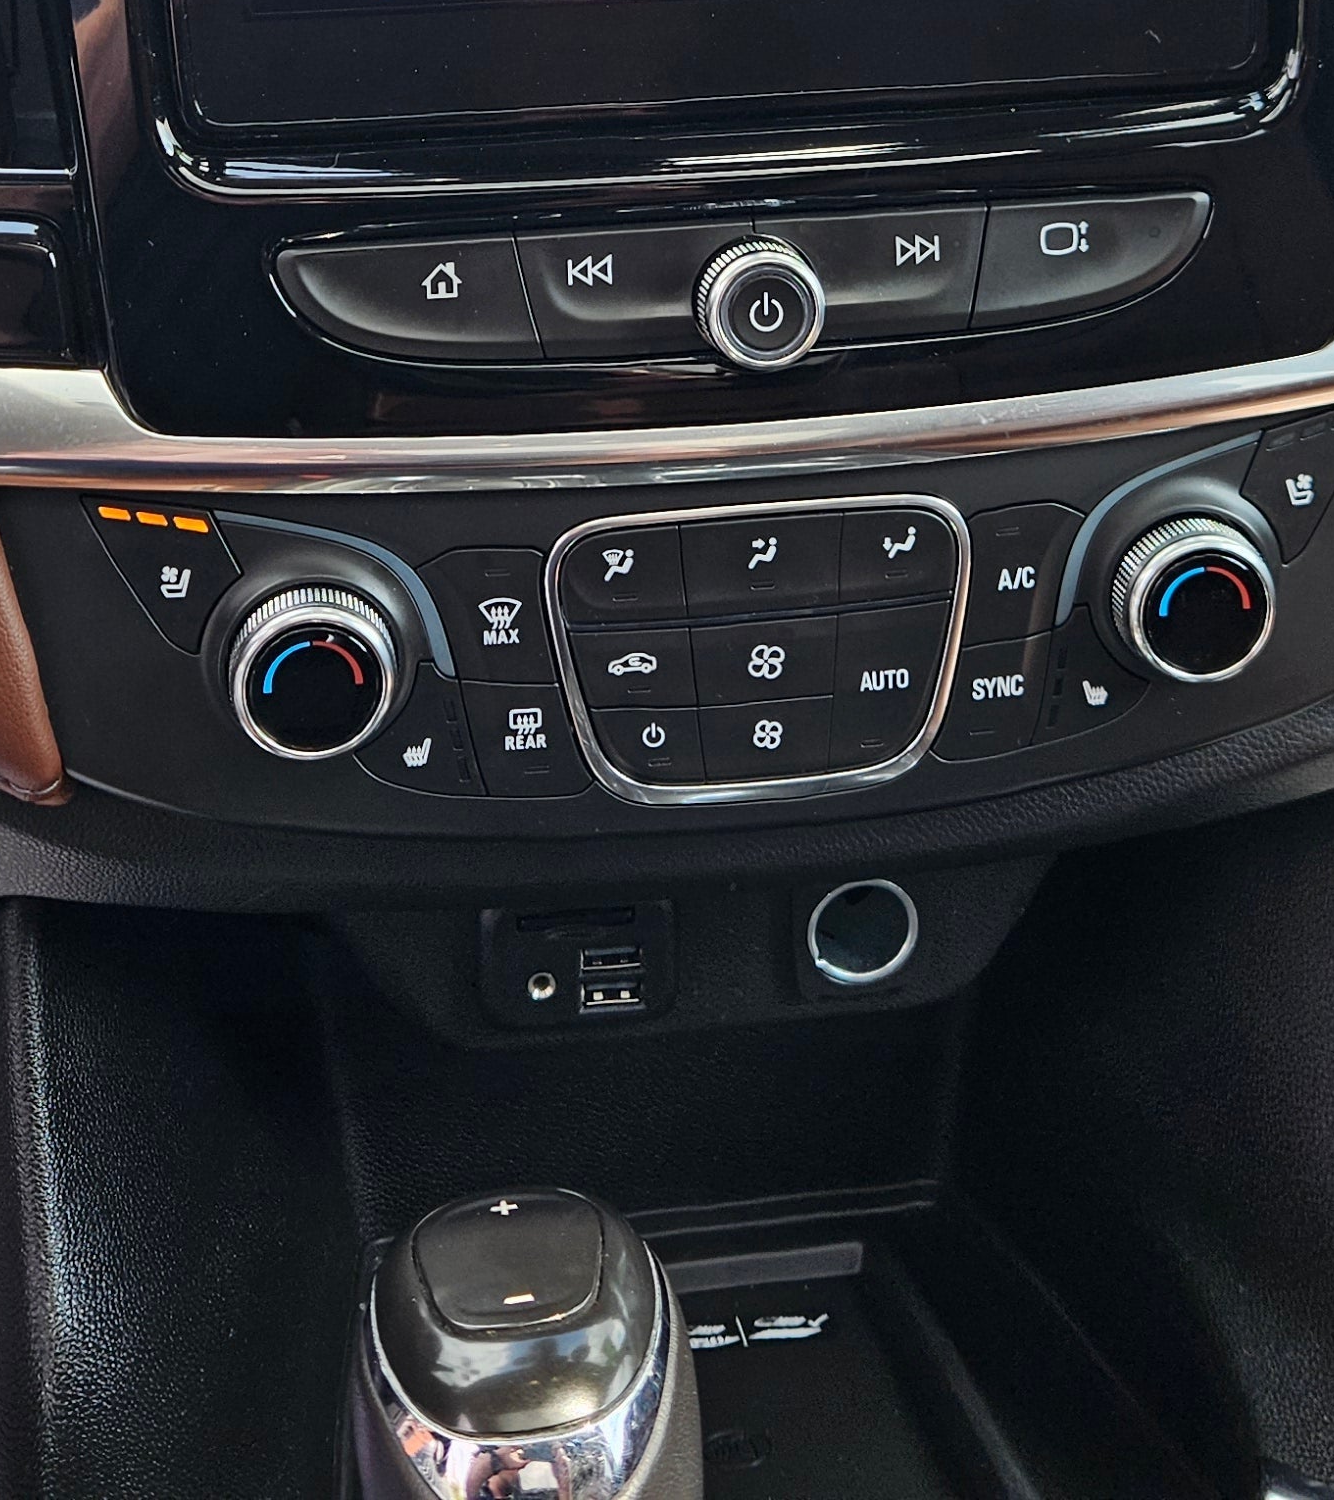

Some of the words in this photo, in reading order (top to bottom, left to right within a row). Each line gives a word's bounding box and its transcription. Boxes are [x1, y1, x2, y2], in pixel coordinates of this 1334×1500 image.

[997, 566, 1035, 591] A/C
[482, 627, 521, 645] MAX
[860, 667, 910, 691] AUTO
[971, 675, 1025, 700] SYNC
[504, 731, 547, 750] REAR
